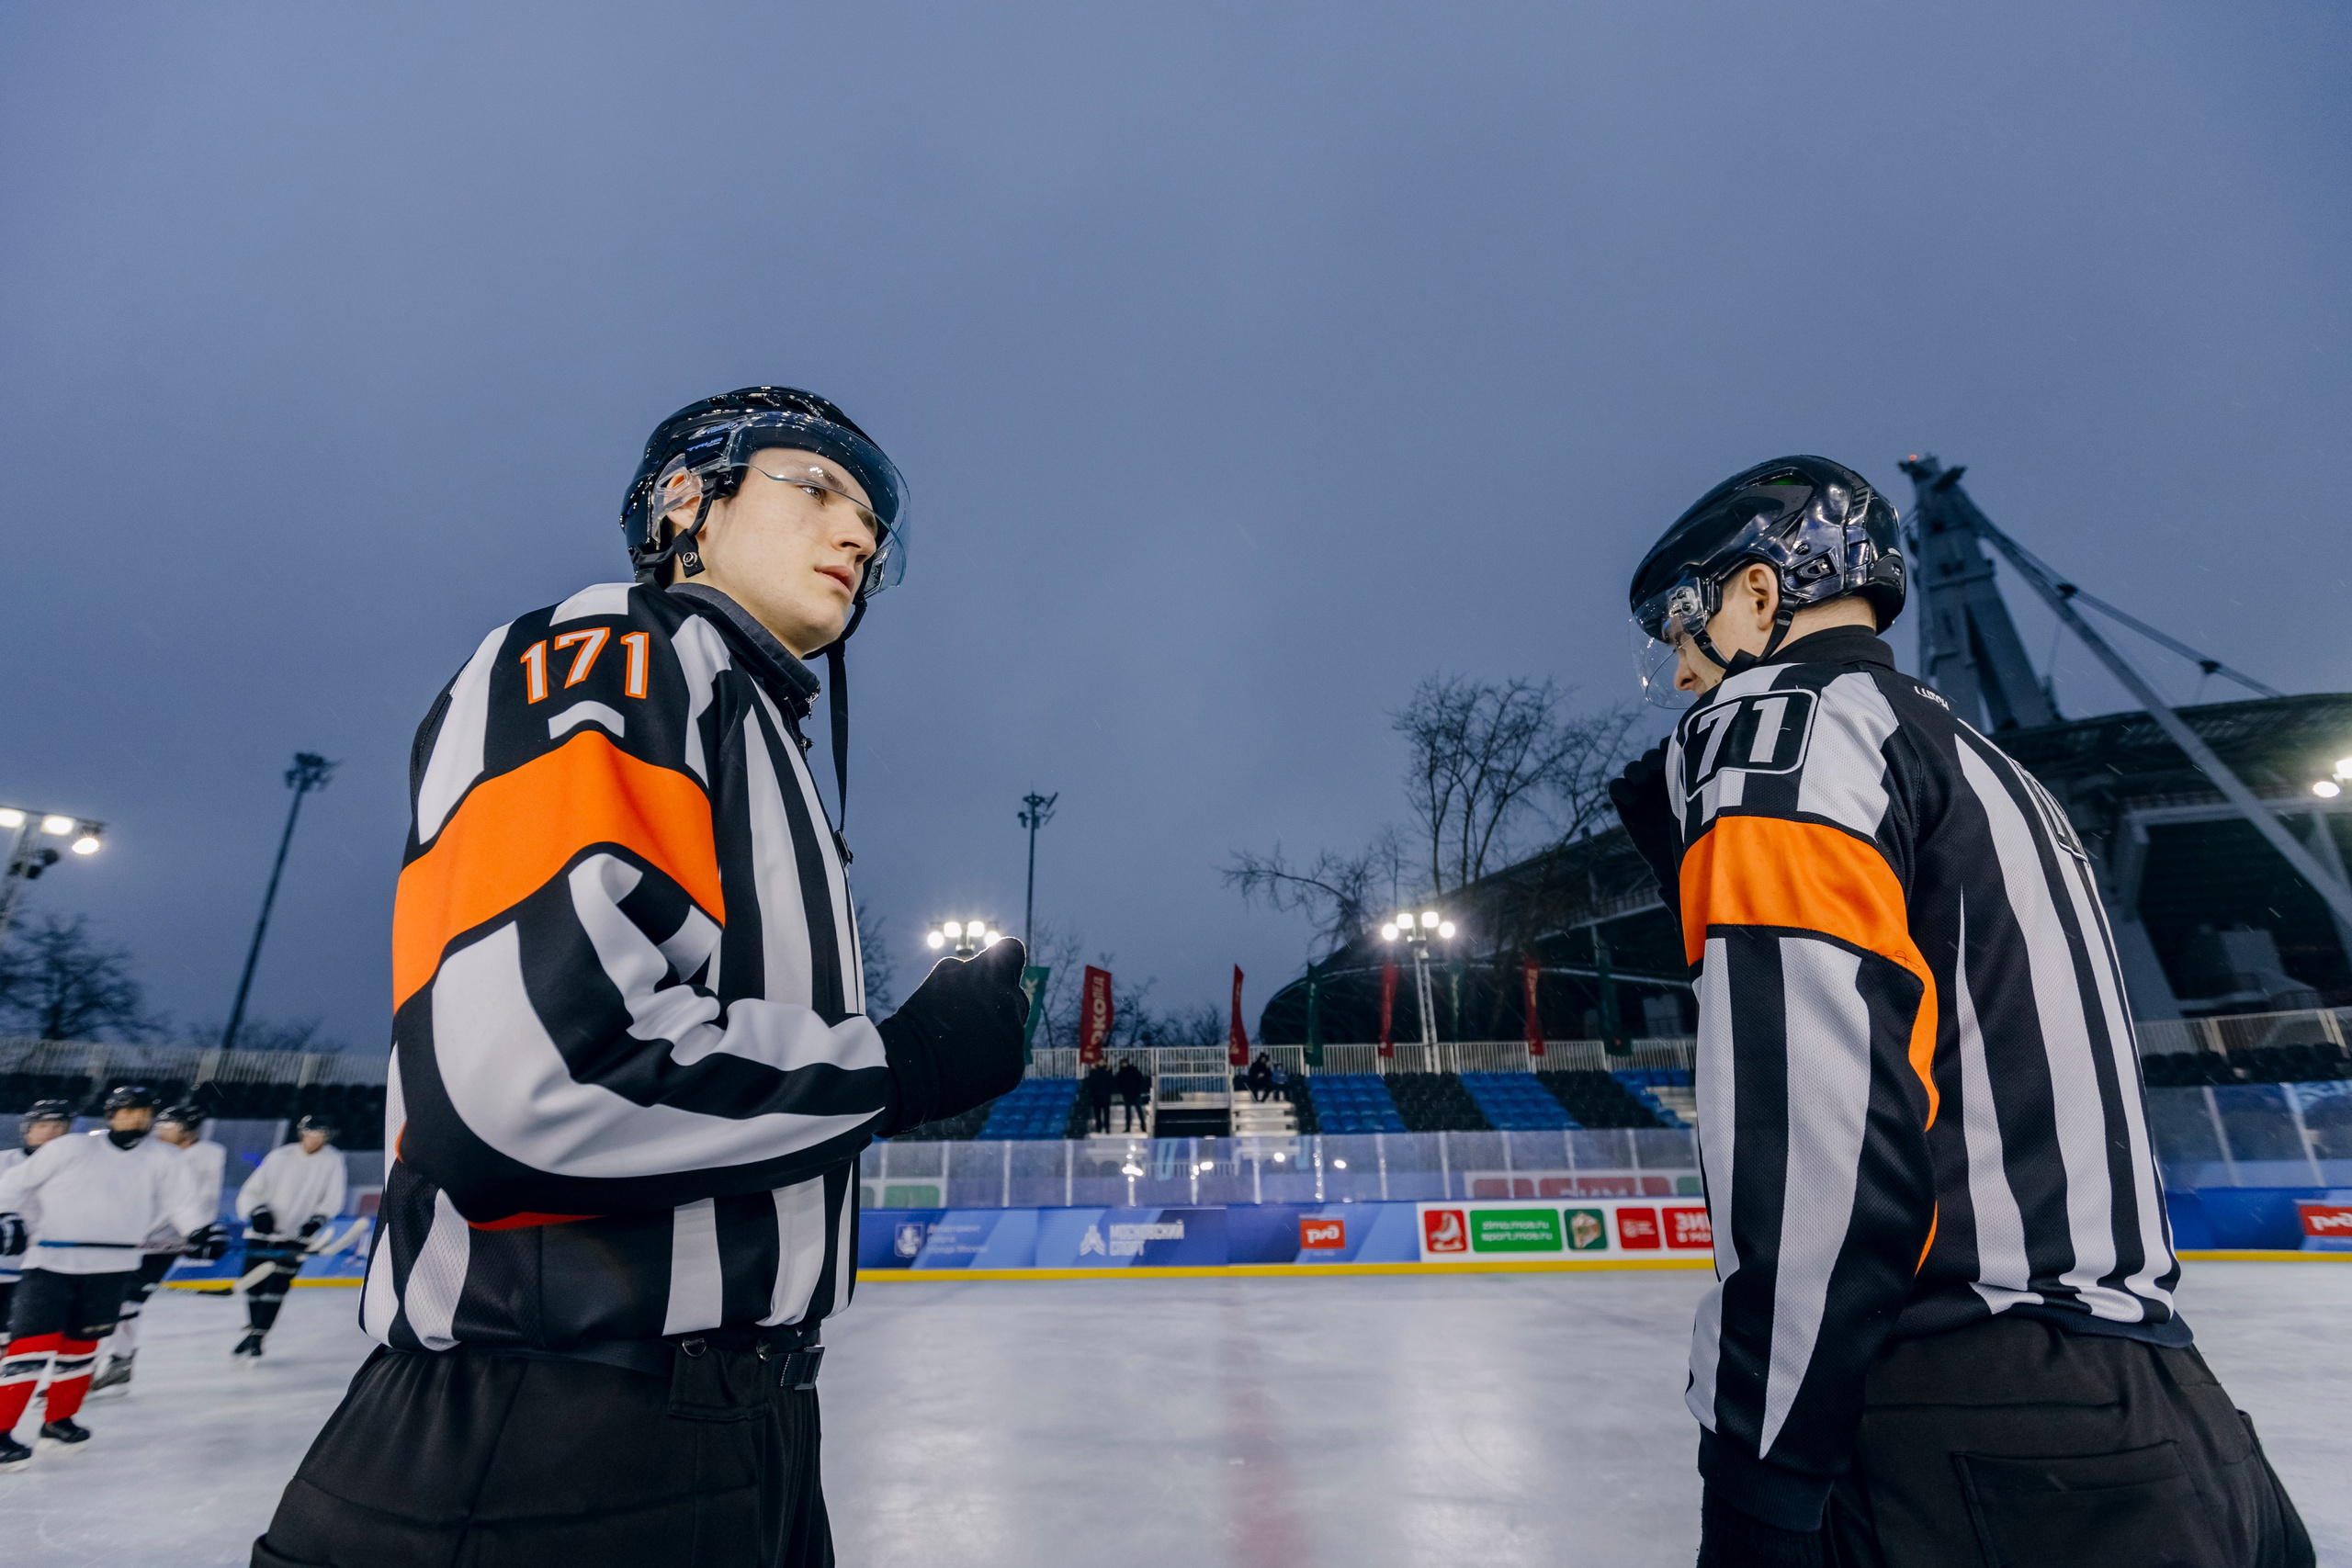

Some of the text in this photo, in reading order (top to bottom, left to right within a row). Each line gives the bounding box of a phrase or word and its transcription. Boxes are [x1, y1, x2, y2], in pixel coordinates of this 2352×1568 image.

[520, 626, 650, 705] 171
[1696, 697, 1789, 784] 71
[1481, 1231, 1553, 1242] sport.mos.ru
